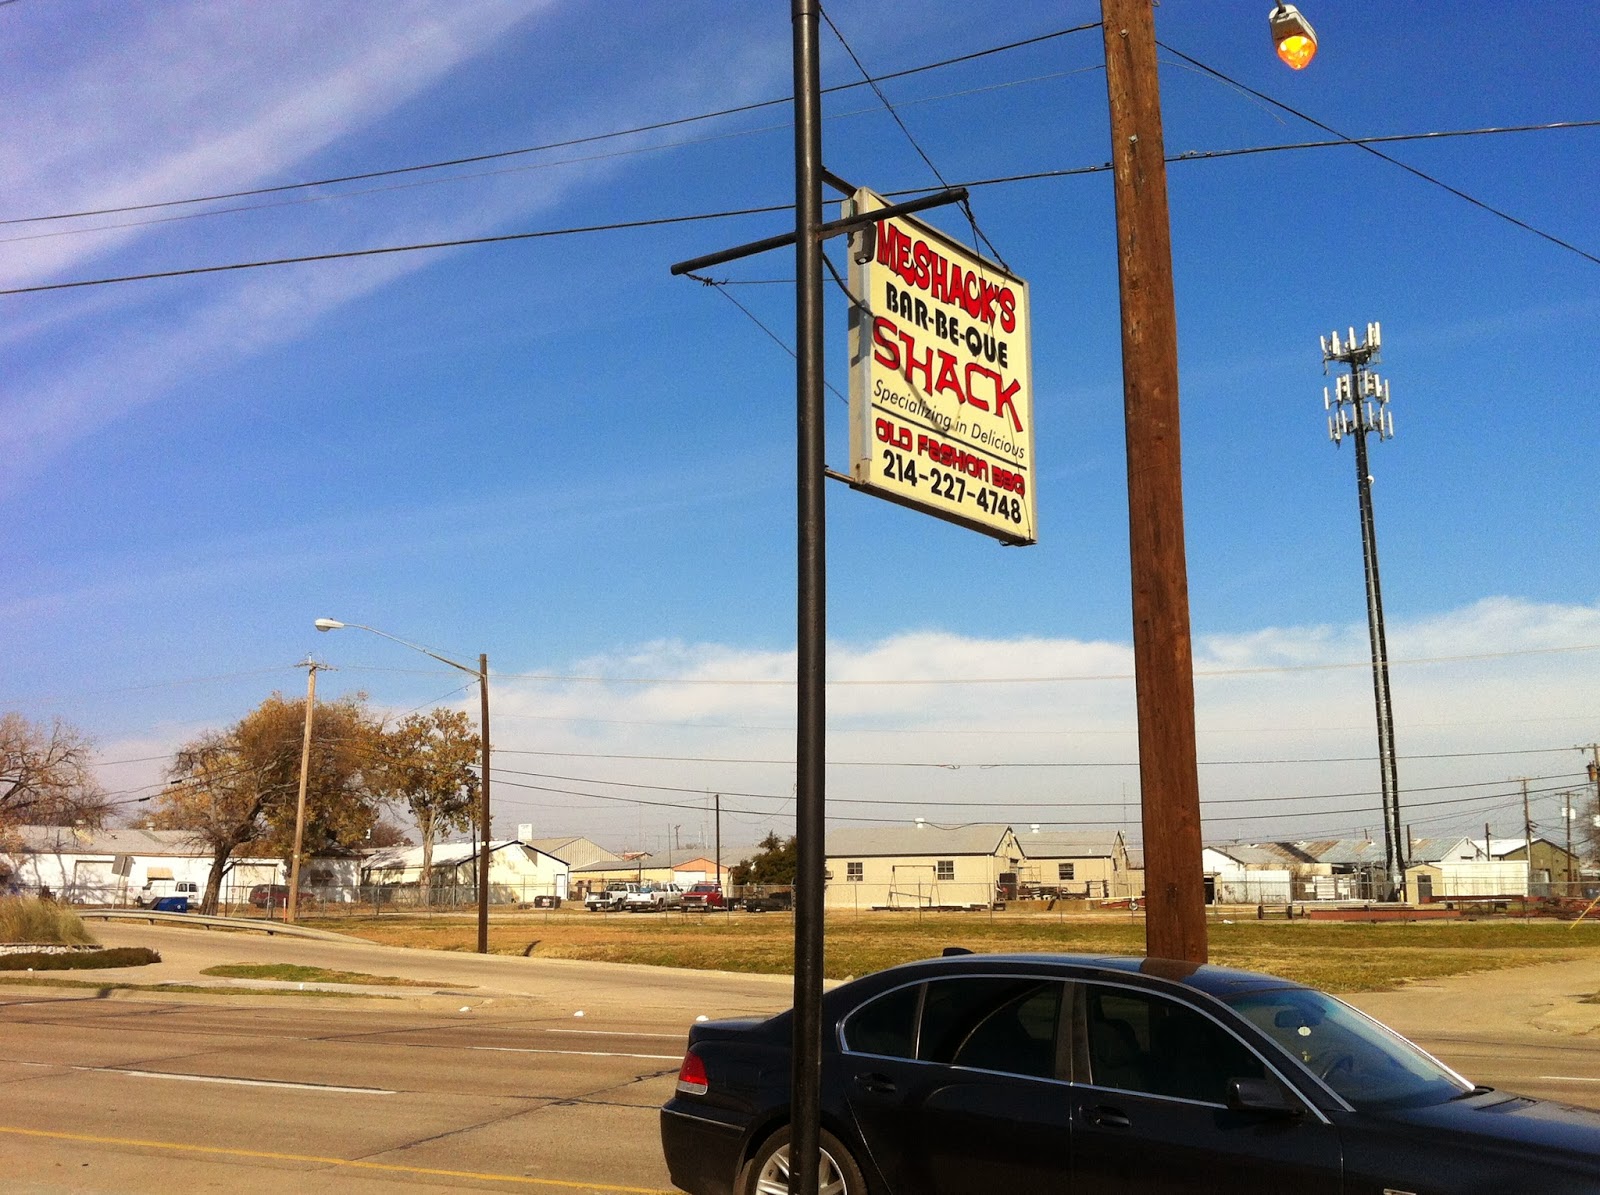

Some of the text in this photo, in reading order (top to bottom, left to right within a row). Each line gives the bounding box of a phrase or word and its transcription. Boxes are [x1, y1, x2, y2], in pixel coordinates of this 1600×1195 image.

[877, 219, 1016, 333] MESHACK'S
[886, 281, 1008, 368] BAR-BE-QUE
[873, 316, 1024, 432] SHACK
[874, 379, 1025, 459] Specializing in Delicious
[875, 417, 913, 452] OLD
[992, 464, 1026, 498] BBQ
[883, 449, 1022, 524] 214-227-4748
